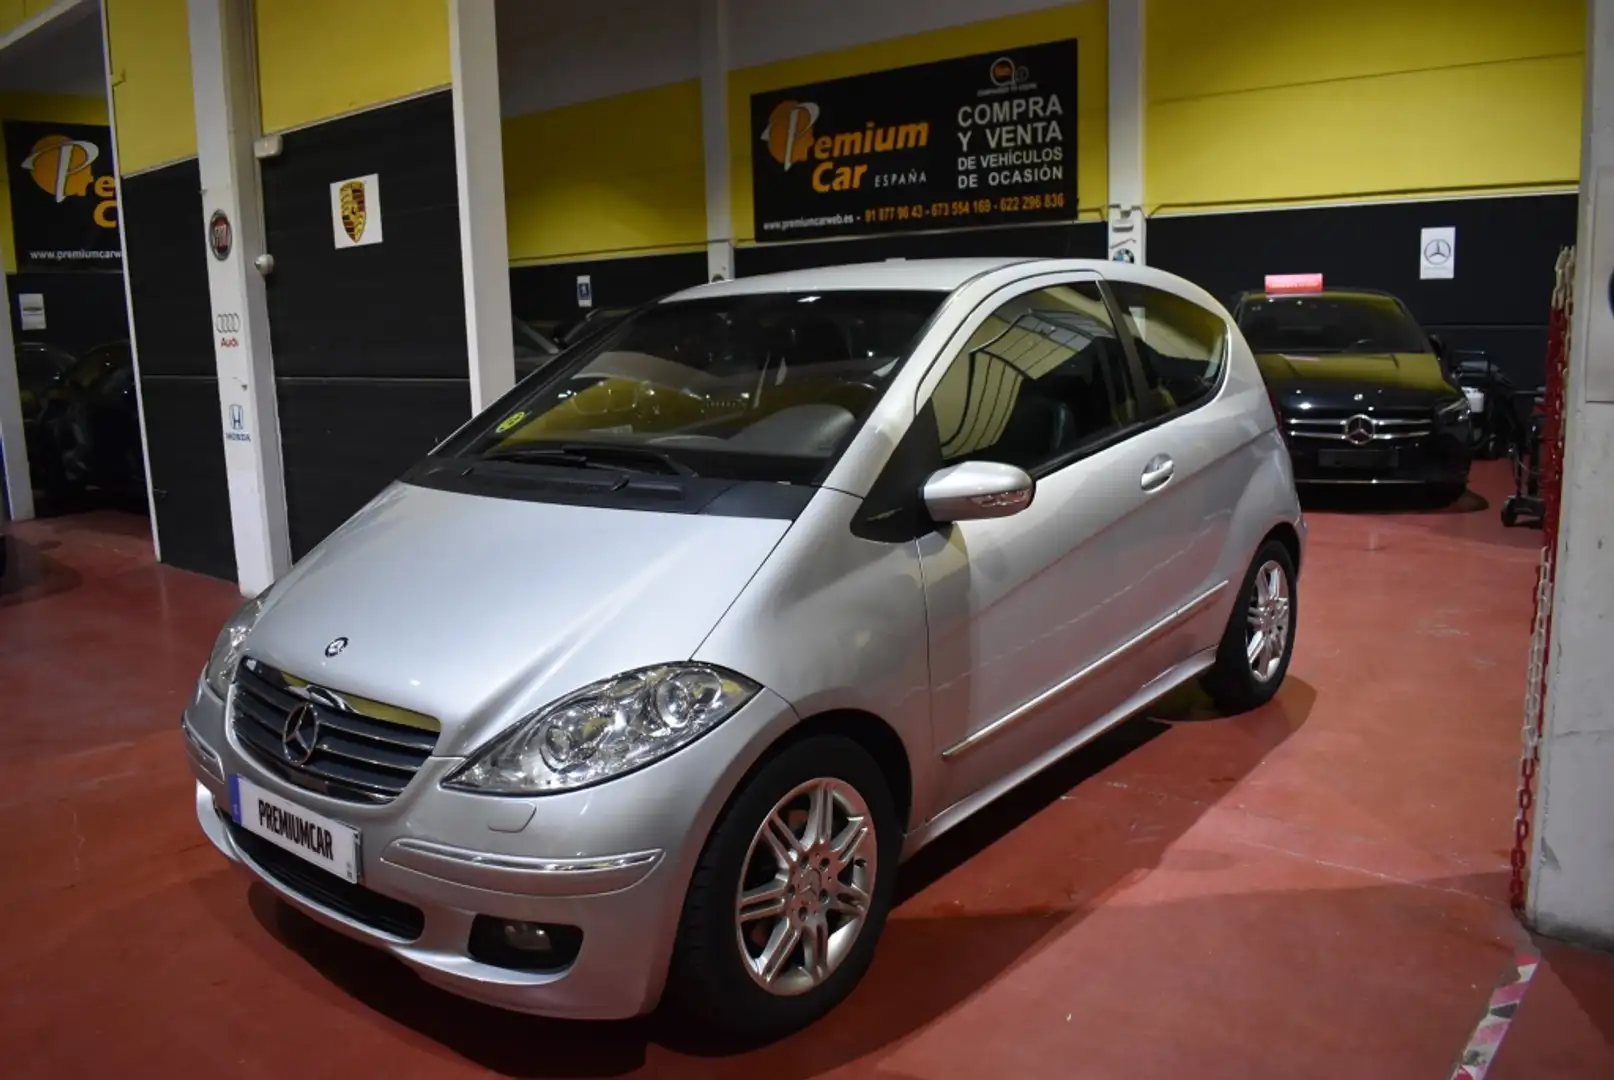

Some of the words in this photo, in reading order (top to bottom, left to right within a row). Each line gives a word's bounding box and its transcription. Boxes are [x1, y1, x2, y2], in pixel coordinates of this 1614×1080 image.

[957, 94, 1064, 128] COMPRA
[760, 101, 930, 171] Premium
[957, 130, 973, 152] Y
[985, 120, 1064, 149] VENTA
[957, 156, 977, 171] DE
[980, 146, 1064, 169] VEHÍCULOS
[812, 160, 868, 194] Car
[874, 168, 928, 188] ESPAÑA
[957, 174, 979, 190] DE
[988, 165, 1064, 187] OCASIÓN
[257, 799, 334, 861] PREMIUMCAR
